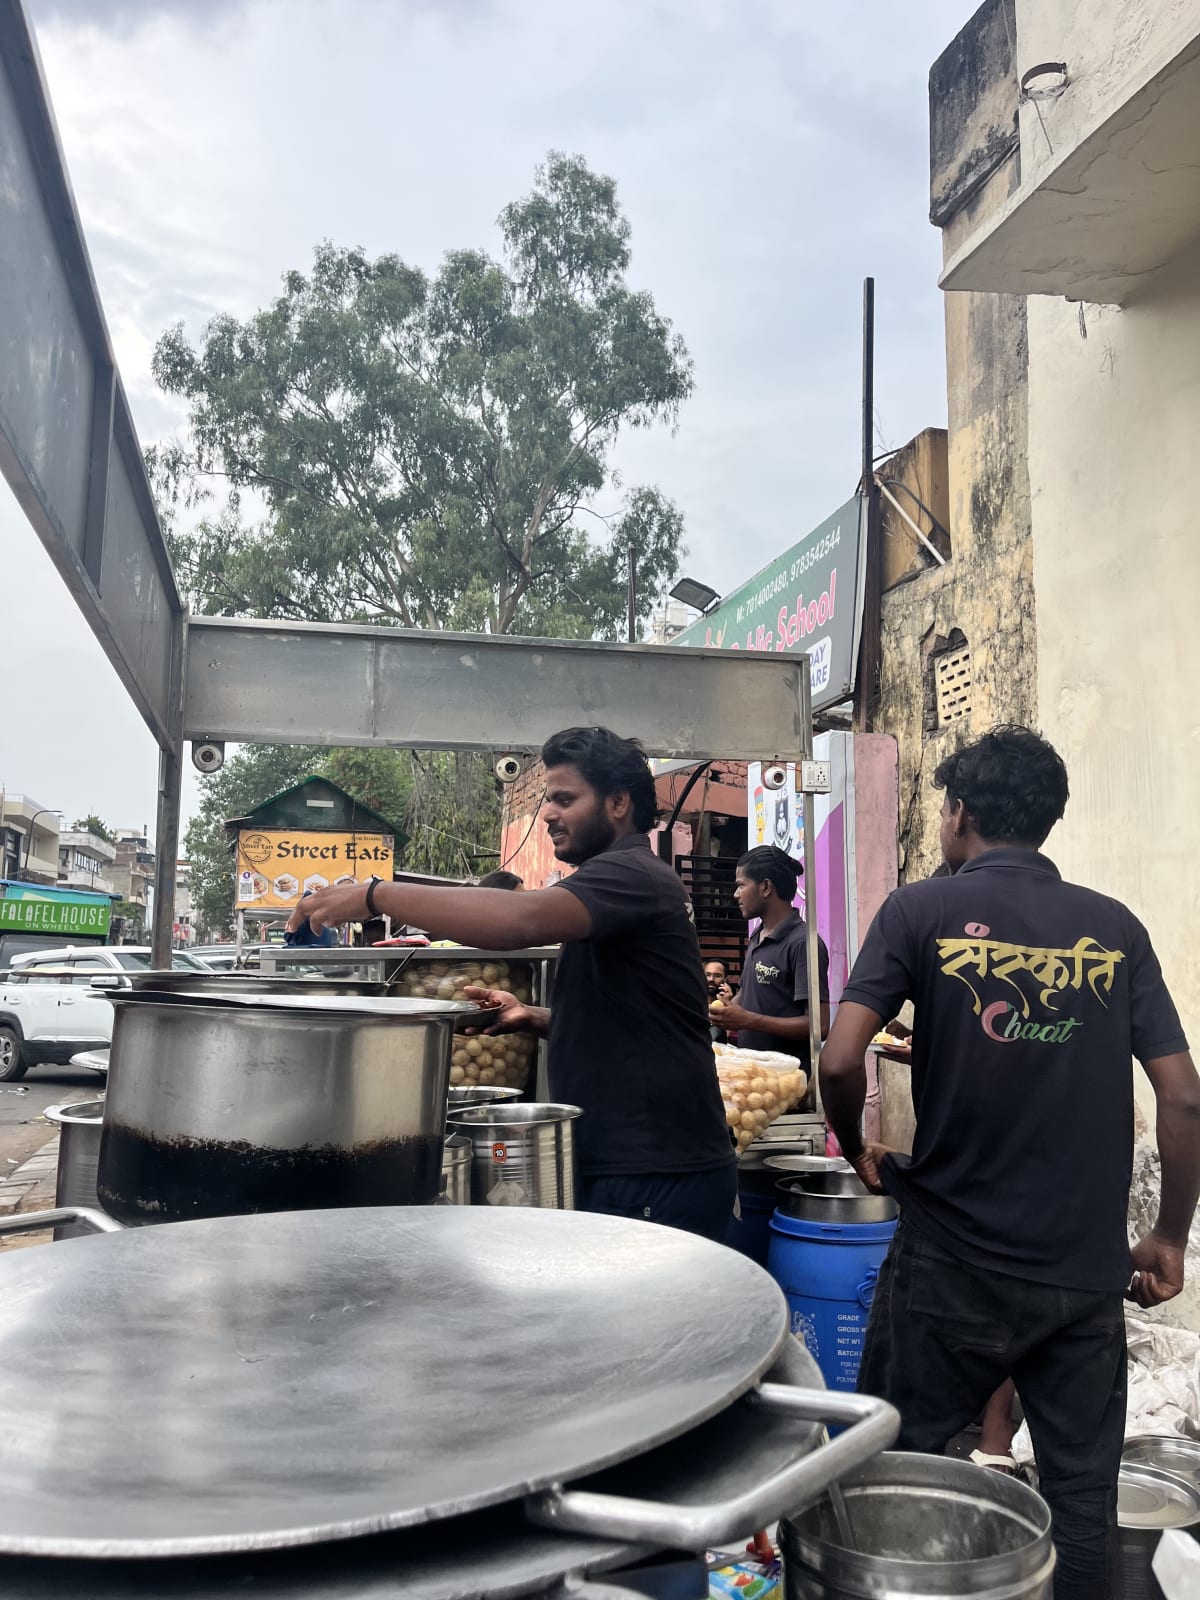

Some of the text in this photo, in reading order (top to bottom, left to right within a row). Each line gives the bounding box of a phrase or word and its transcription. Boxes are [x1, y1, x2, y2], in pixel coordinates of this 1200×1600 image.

[746, 570, 789, 617] 7014002480,
[790, 524, 841, 583] 9783542544
[775, 567, 837, 653] School
[810, 664, 828, 689] ARE
[276, 840, 390, 861] Street Eats
[1, 902, 106, 926] FALAFEL HOUSE
[42, 922, 81, 931] WHEELS
[936, 922, 1126, 1020] संस्कृति
[981, 1001, 1084, 1043] Chaat
[837, 1314, 860, 1322] GRADE
